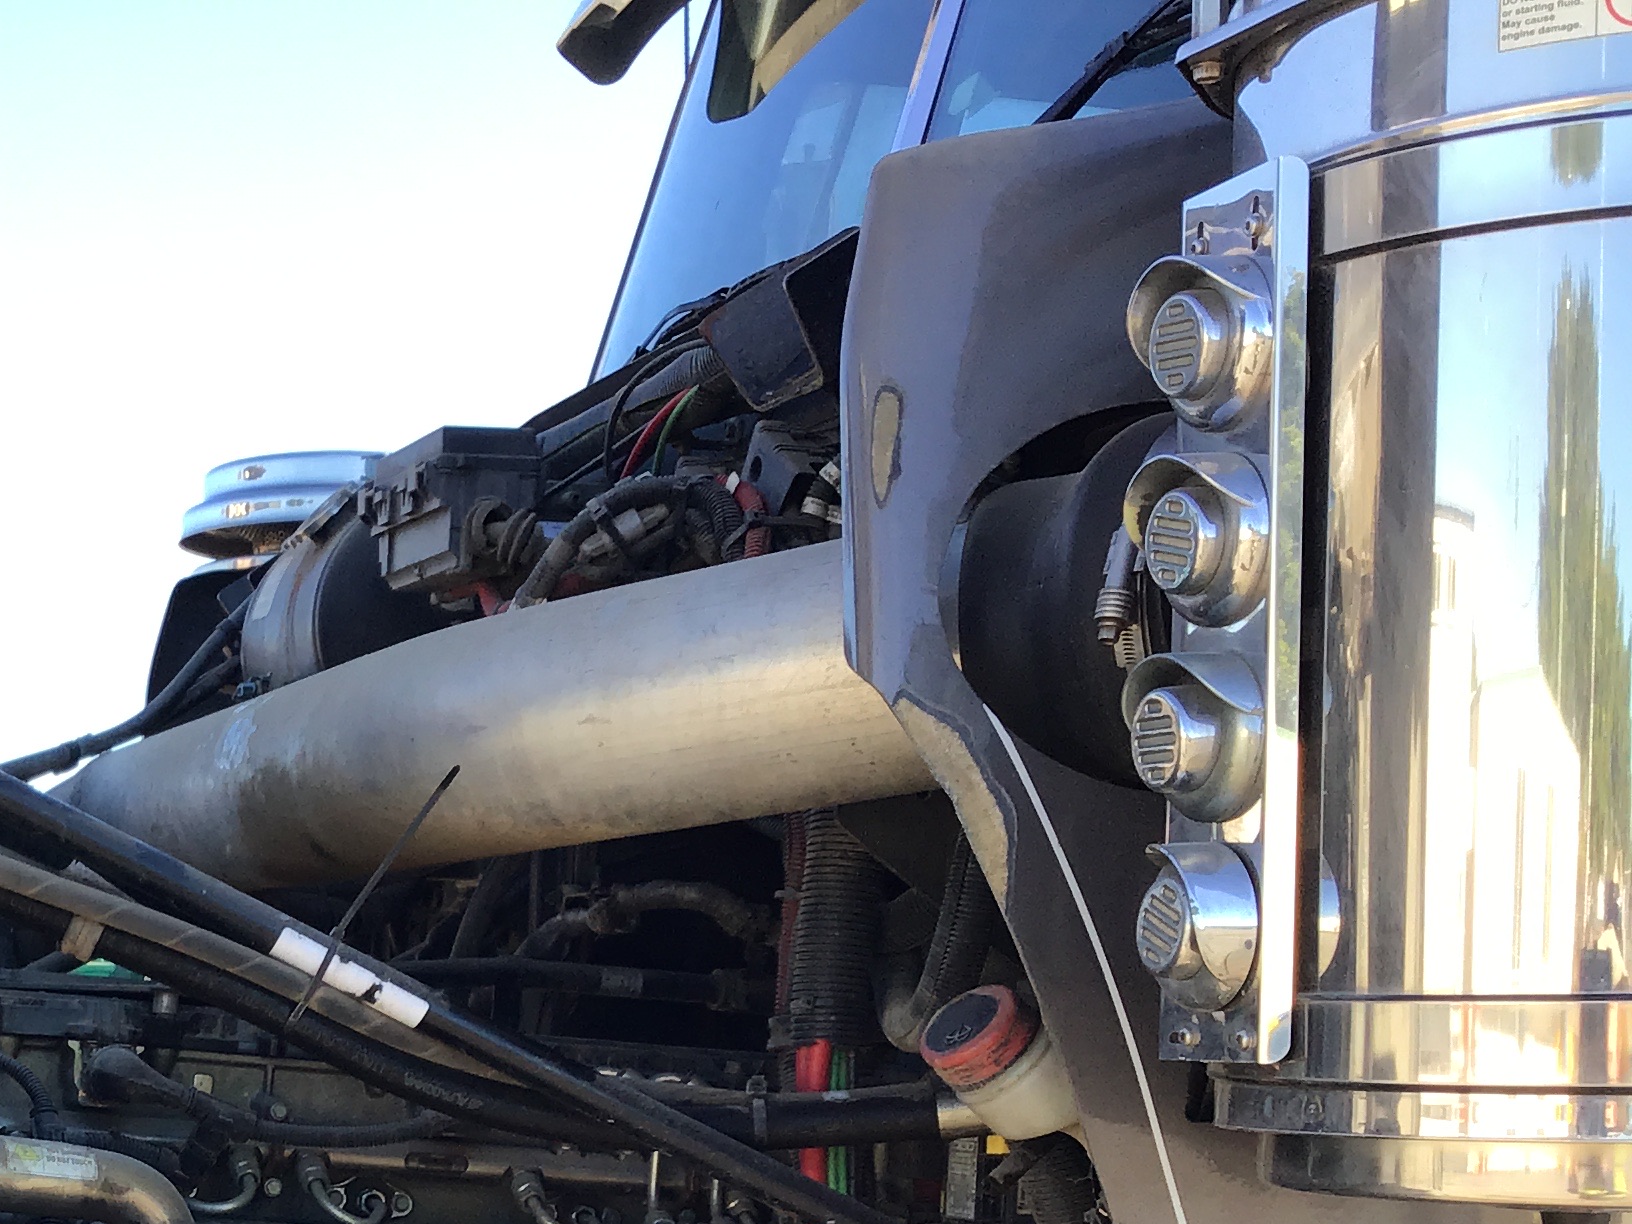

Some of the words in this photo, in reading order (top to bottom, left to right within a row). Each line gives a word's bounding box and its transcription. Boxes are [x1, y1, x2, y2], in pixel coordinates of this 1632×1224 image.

[1502, 10, 1512, 18] or
[1515, 2, 1554, 16] starting
[1557, 0, 1584, 8] fluid.
[1501, 20, 1522, 29] May
[1525, 14, 1556, 26] cause
[1501, 29, 1535, 41] engine
[1538, 22, 1582, 35] damage.
